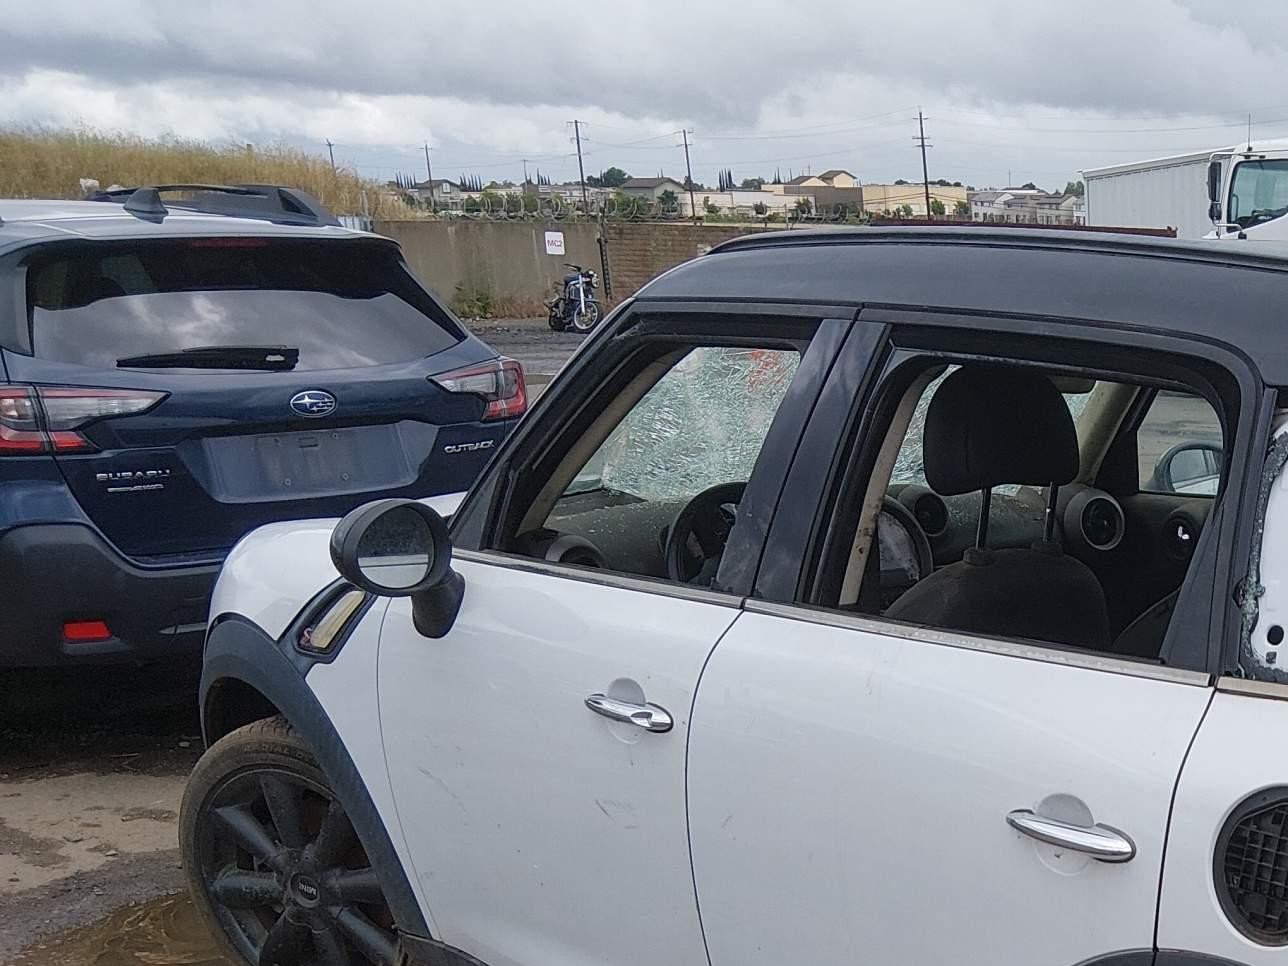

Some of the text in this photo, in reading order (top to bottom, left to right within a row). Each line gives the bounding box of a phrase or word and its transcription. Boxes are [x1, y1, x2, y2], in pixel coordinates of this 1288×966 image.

[444, 439, 495, 454] OUTBACK
[96, 469, 171, 481] SUBARU
[298, 881, 317, 896] MINI
